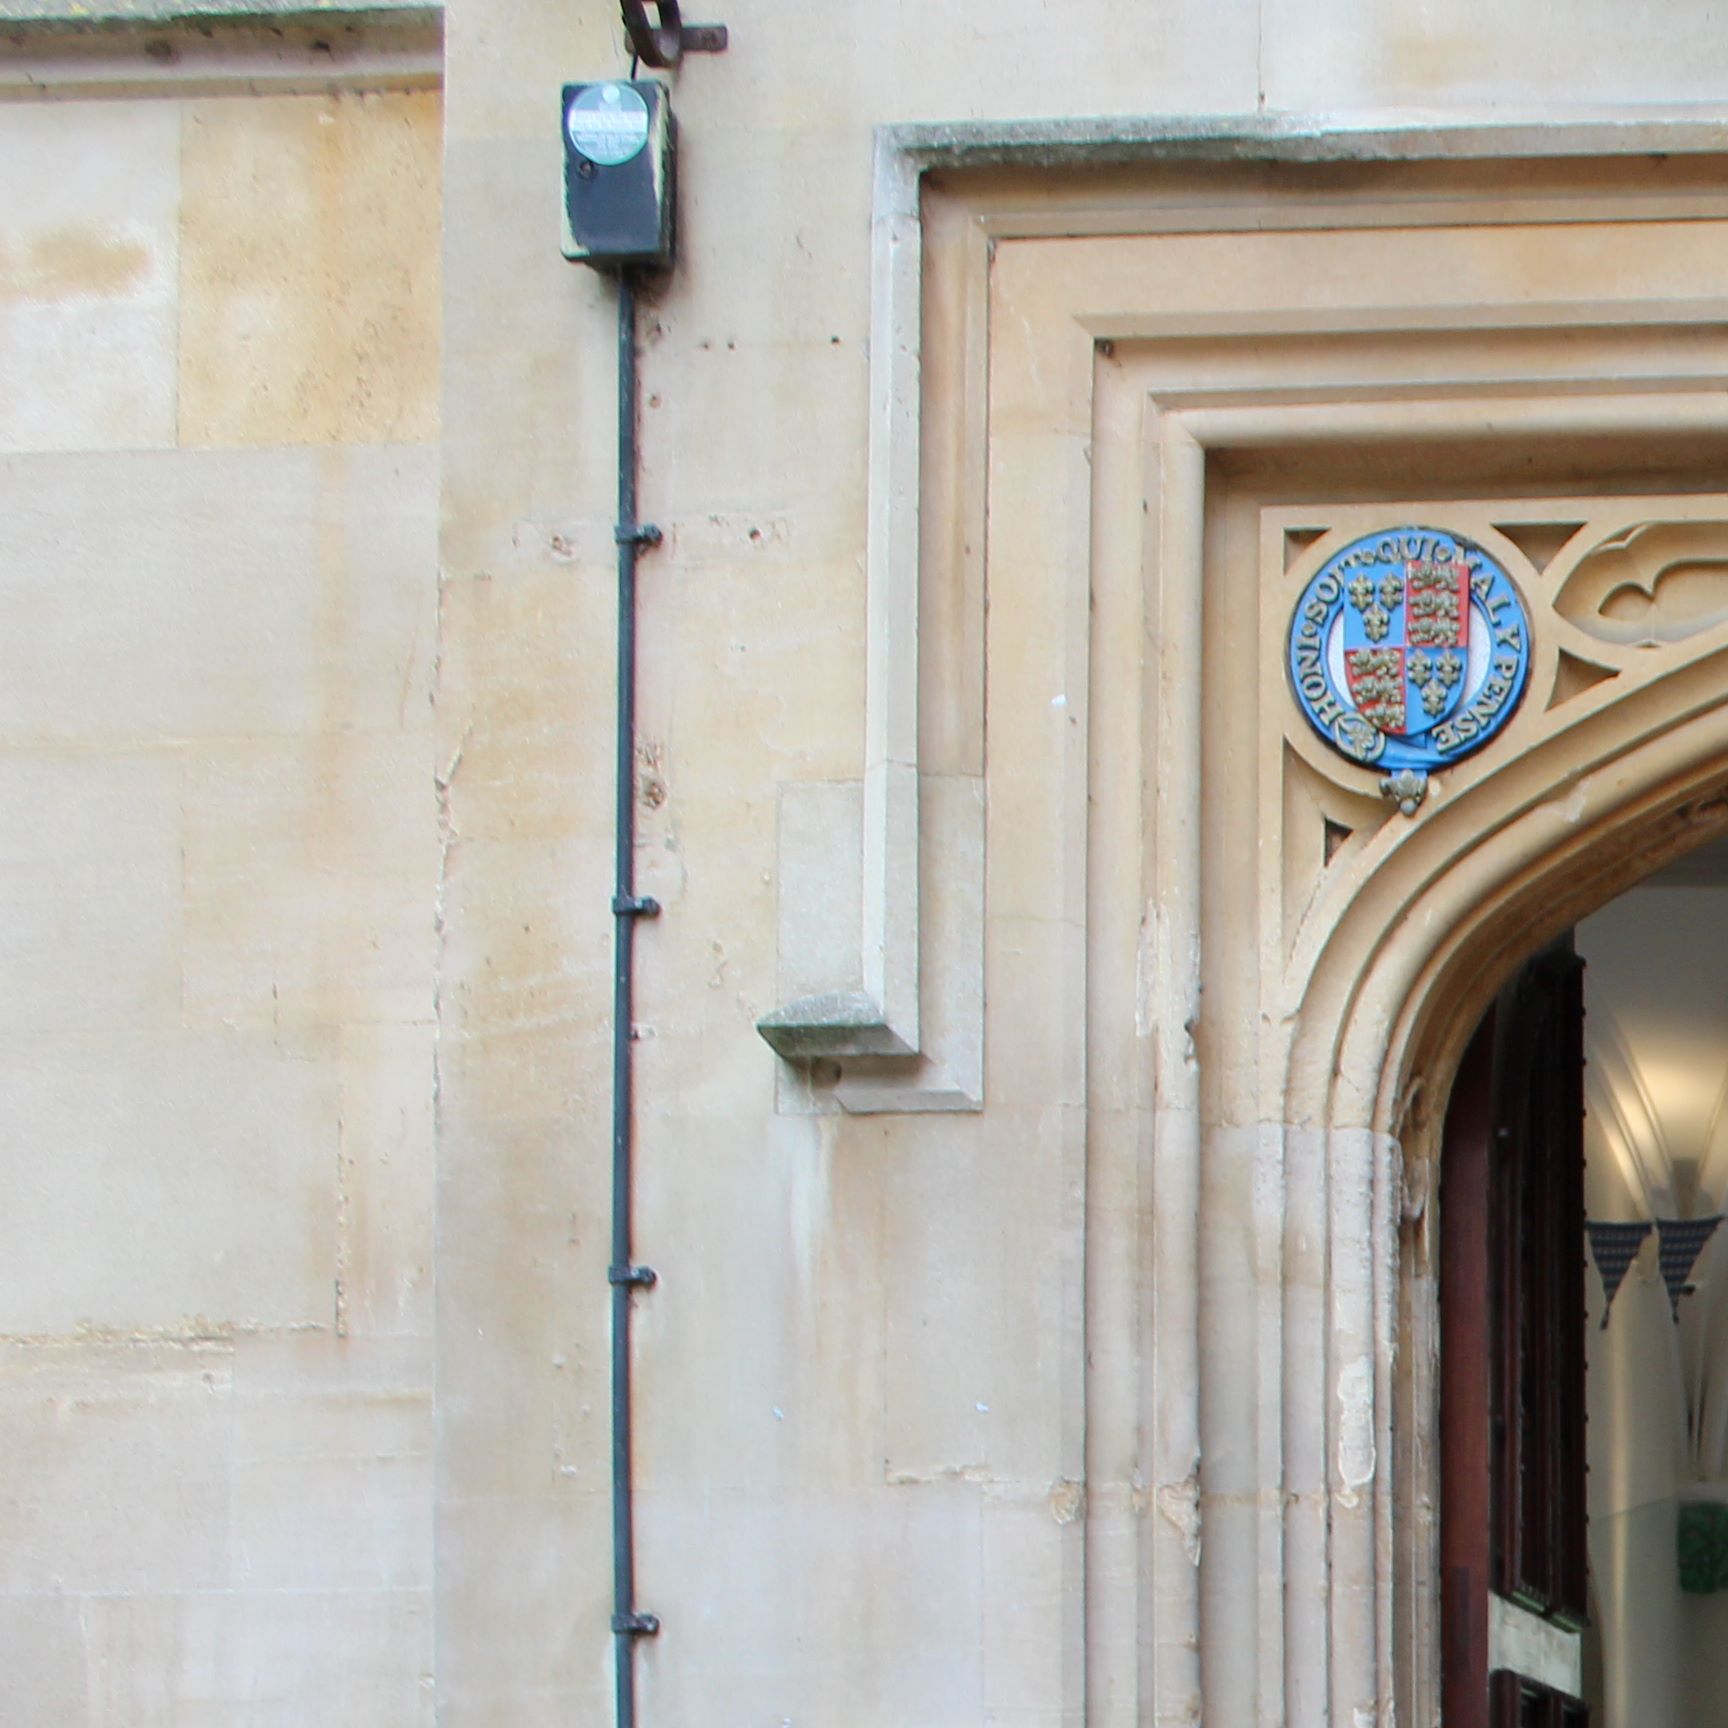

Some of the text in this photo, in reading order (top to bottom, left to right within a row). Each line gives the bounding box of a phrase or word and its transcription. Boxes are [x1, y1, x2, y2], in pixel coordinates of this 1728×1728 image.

[1377, 535, 1437, 565] QUI
[1496, 624, 1521, 654] Y
[1296, 637, 1345, 728] HONI
[1432, 655, 1520, 753] PENSE
